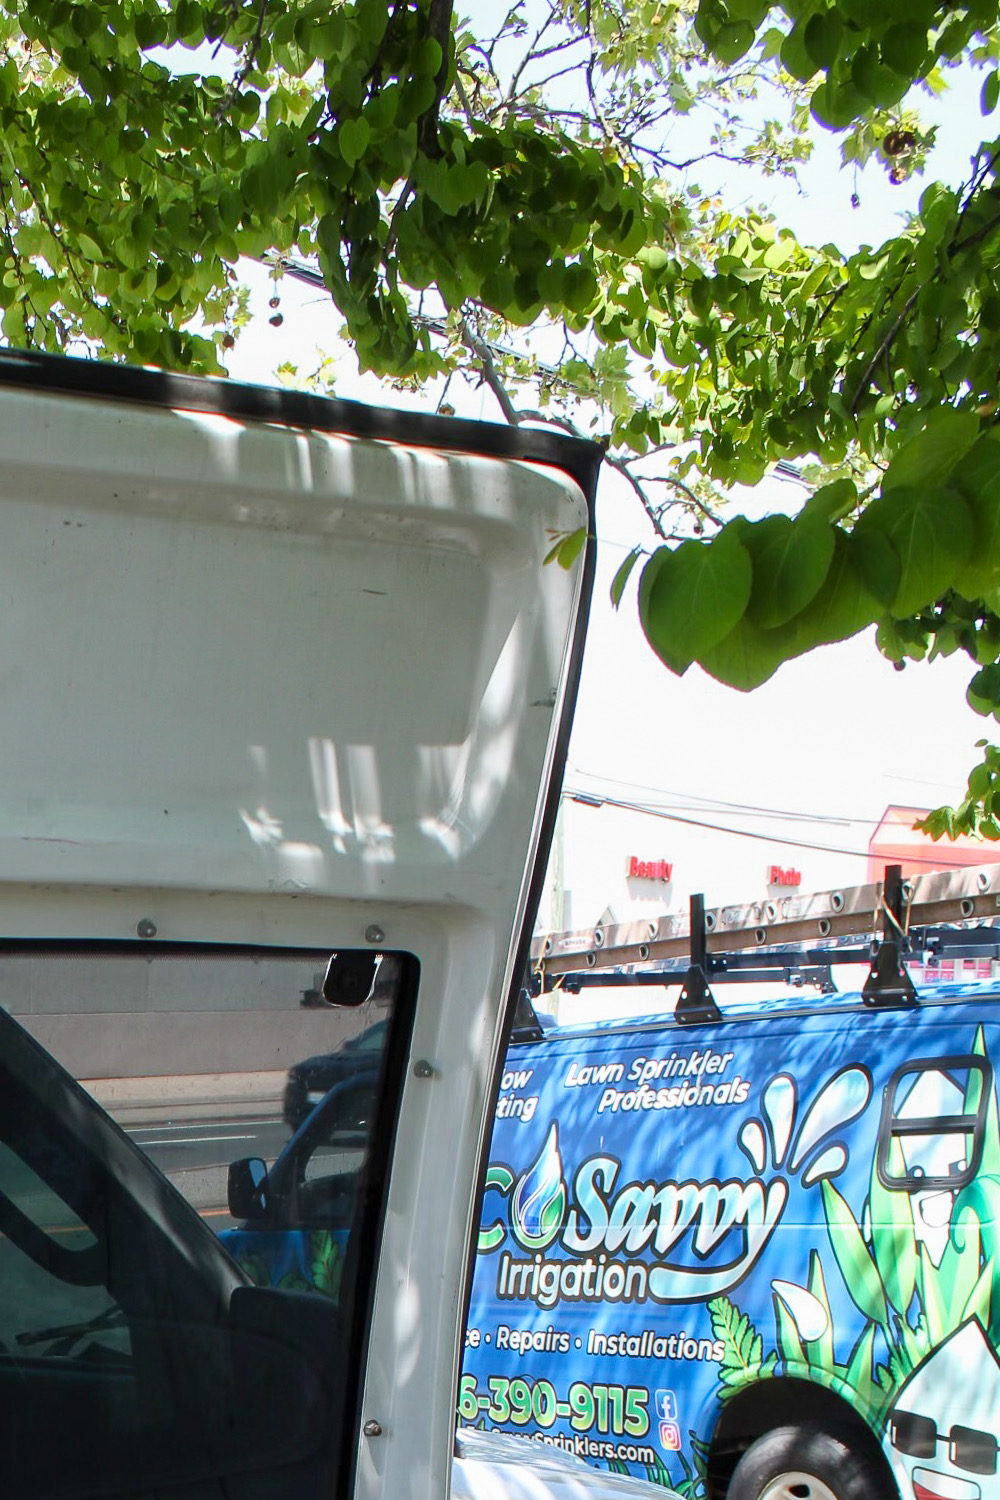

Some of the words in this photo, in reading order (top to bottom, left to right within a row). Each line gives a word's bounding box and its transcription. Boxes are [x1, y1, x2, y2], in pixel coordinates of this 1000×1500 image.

[630, 856, 673, 884] Beauty
[770, 866, 801, 886] Photo
[499, 1068, 534, 1091] ow
[564, 1062, 625, 1088] Lawn
[627, 1048, 734, 1085] Sprinkler
[495, 1093, 539, 1123] ting
[597, 1075, 751, 1114] Professionals
[561, 1156, 788, 1302] Savvy
[498, 1253, 648, 1306] Irrigation
[495, 1325, 570, 1355] Repairs
[587, 1329, 726, 1363] Installations
